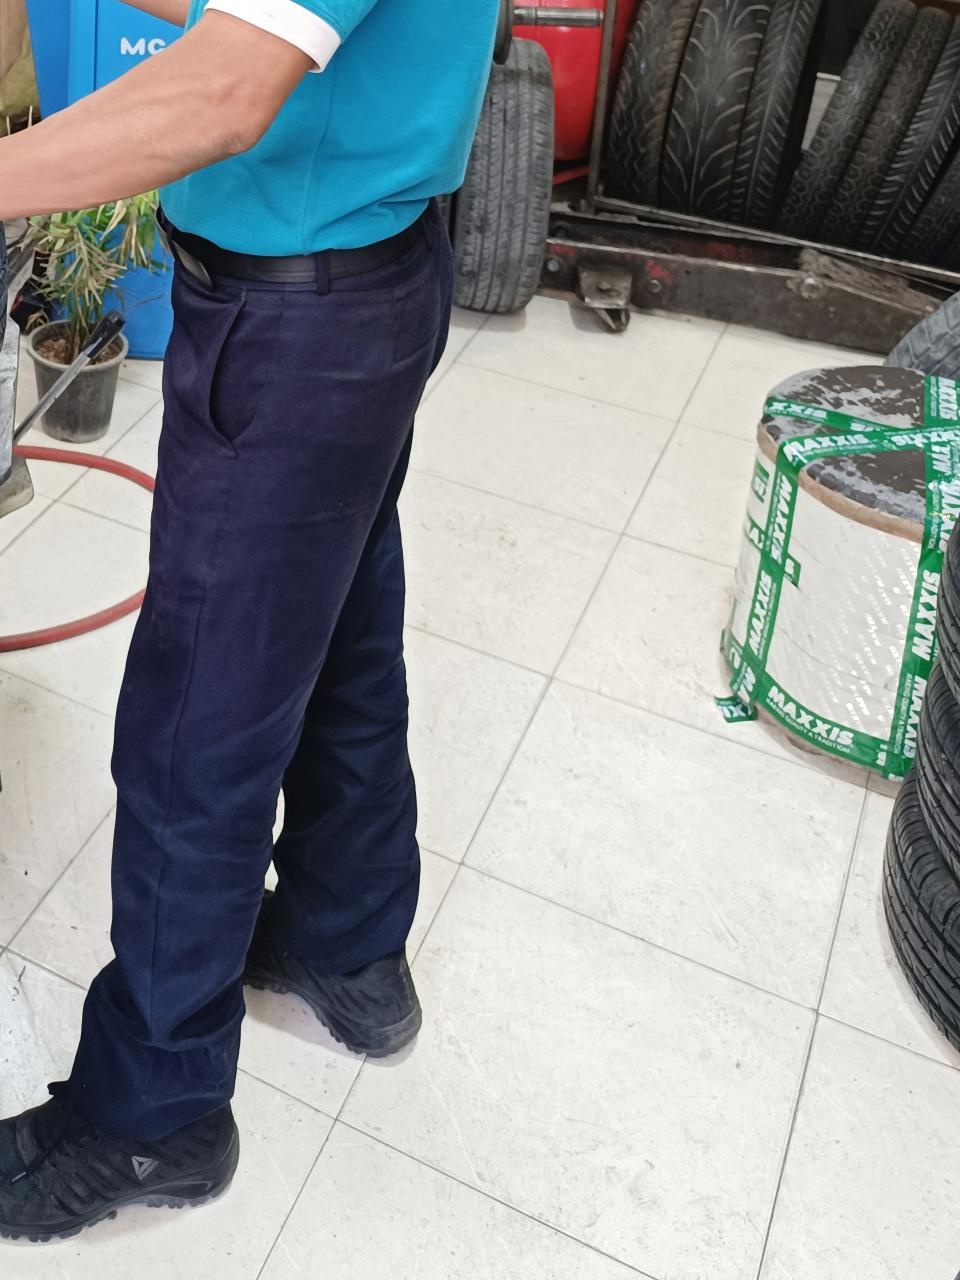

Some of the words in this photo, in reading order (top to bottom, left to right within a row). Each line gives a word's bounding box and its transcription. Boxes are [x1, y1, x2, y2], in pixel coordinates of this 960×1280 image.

[783, 433, 869, 465] MAXXIS
[771, 474, 793, 564] MAXXIS
[749, 570, 772, 656] MAXXIS
[911, 569, 941, 661] MAXXIS
[768, 685, 854, 746] MAXXIS
